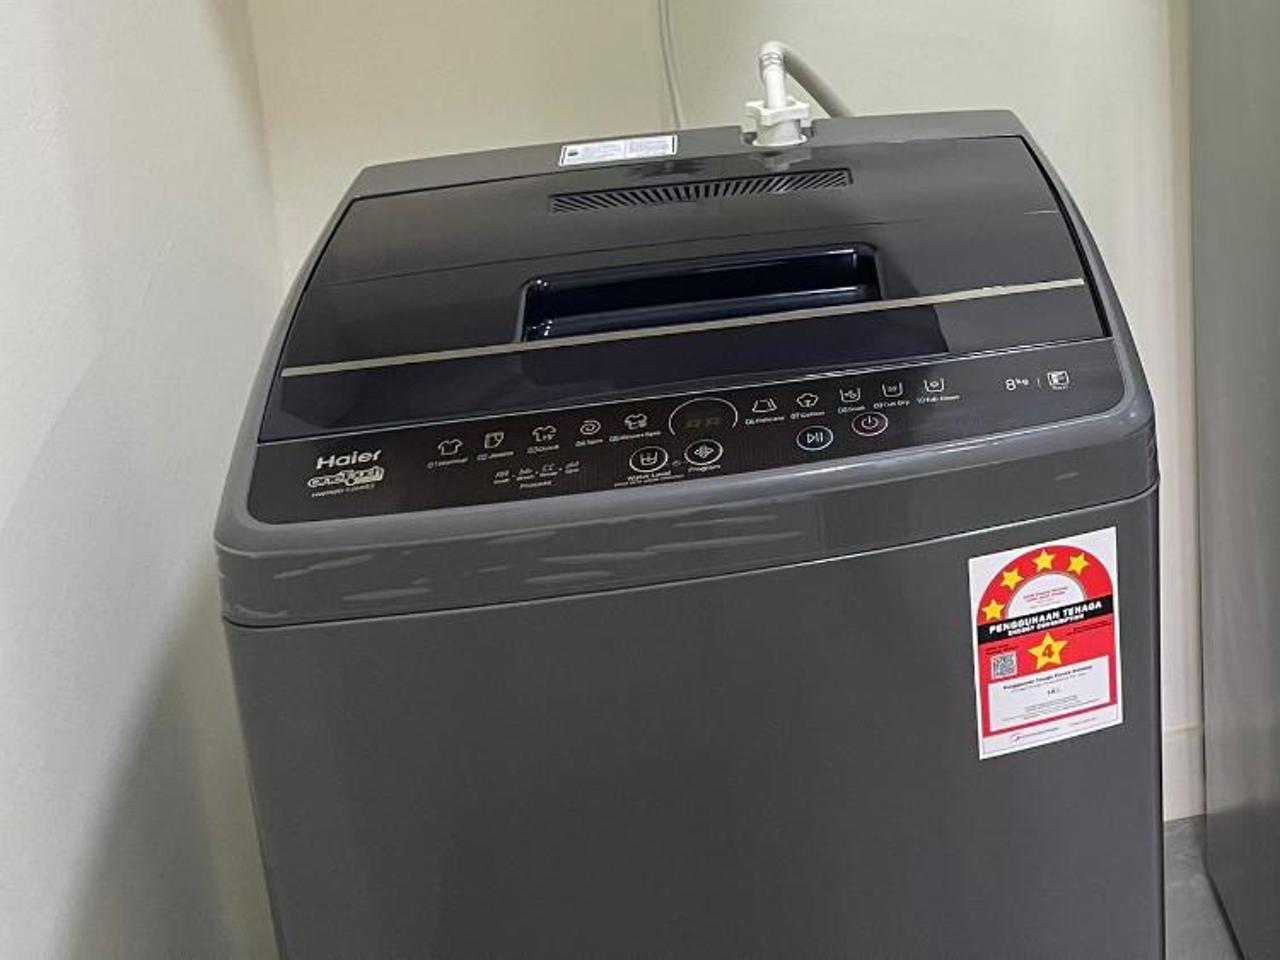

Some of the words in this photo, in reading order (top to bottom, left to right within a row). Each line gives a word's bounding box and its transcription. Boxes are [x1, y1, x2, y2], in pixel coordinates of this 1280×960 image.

[317, 450, 382, 471] Haier
[989, 610, 1060, 635] PENGGUNAAN
[1062, 601, 1102, 618] TENAGA
[1042, 644, 1054, 657] 4
